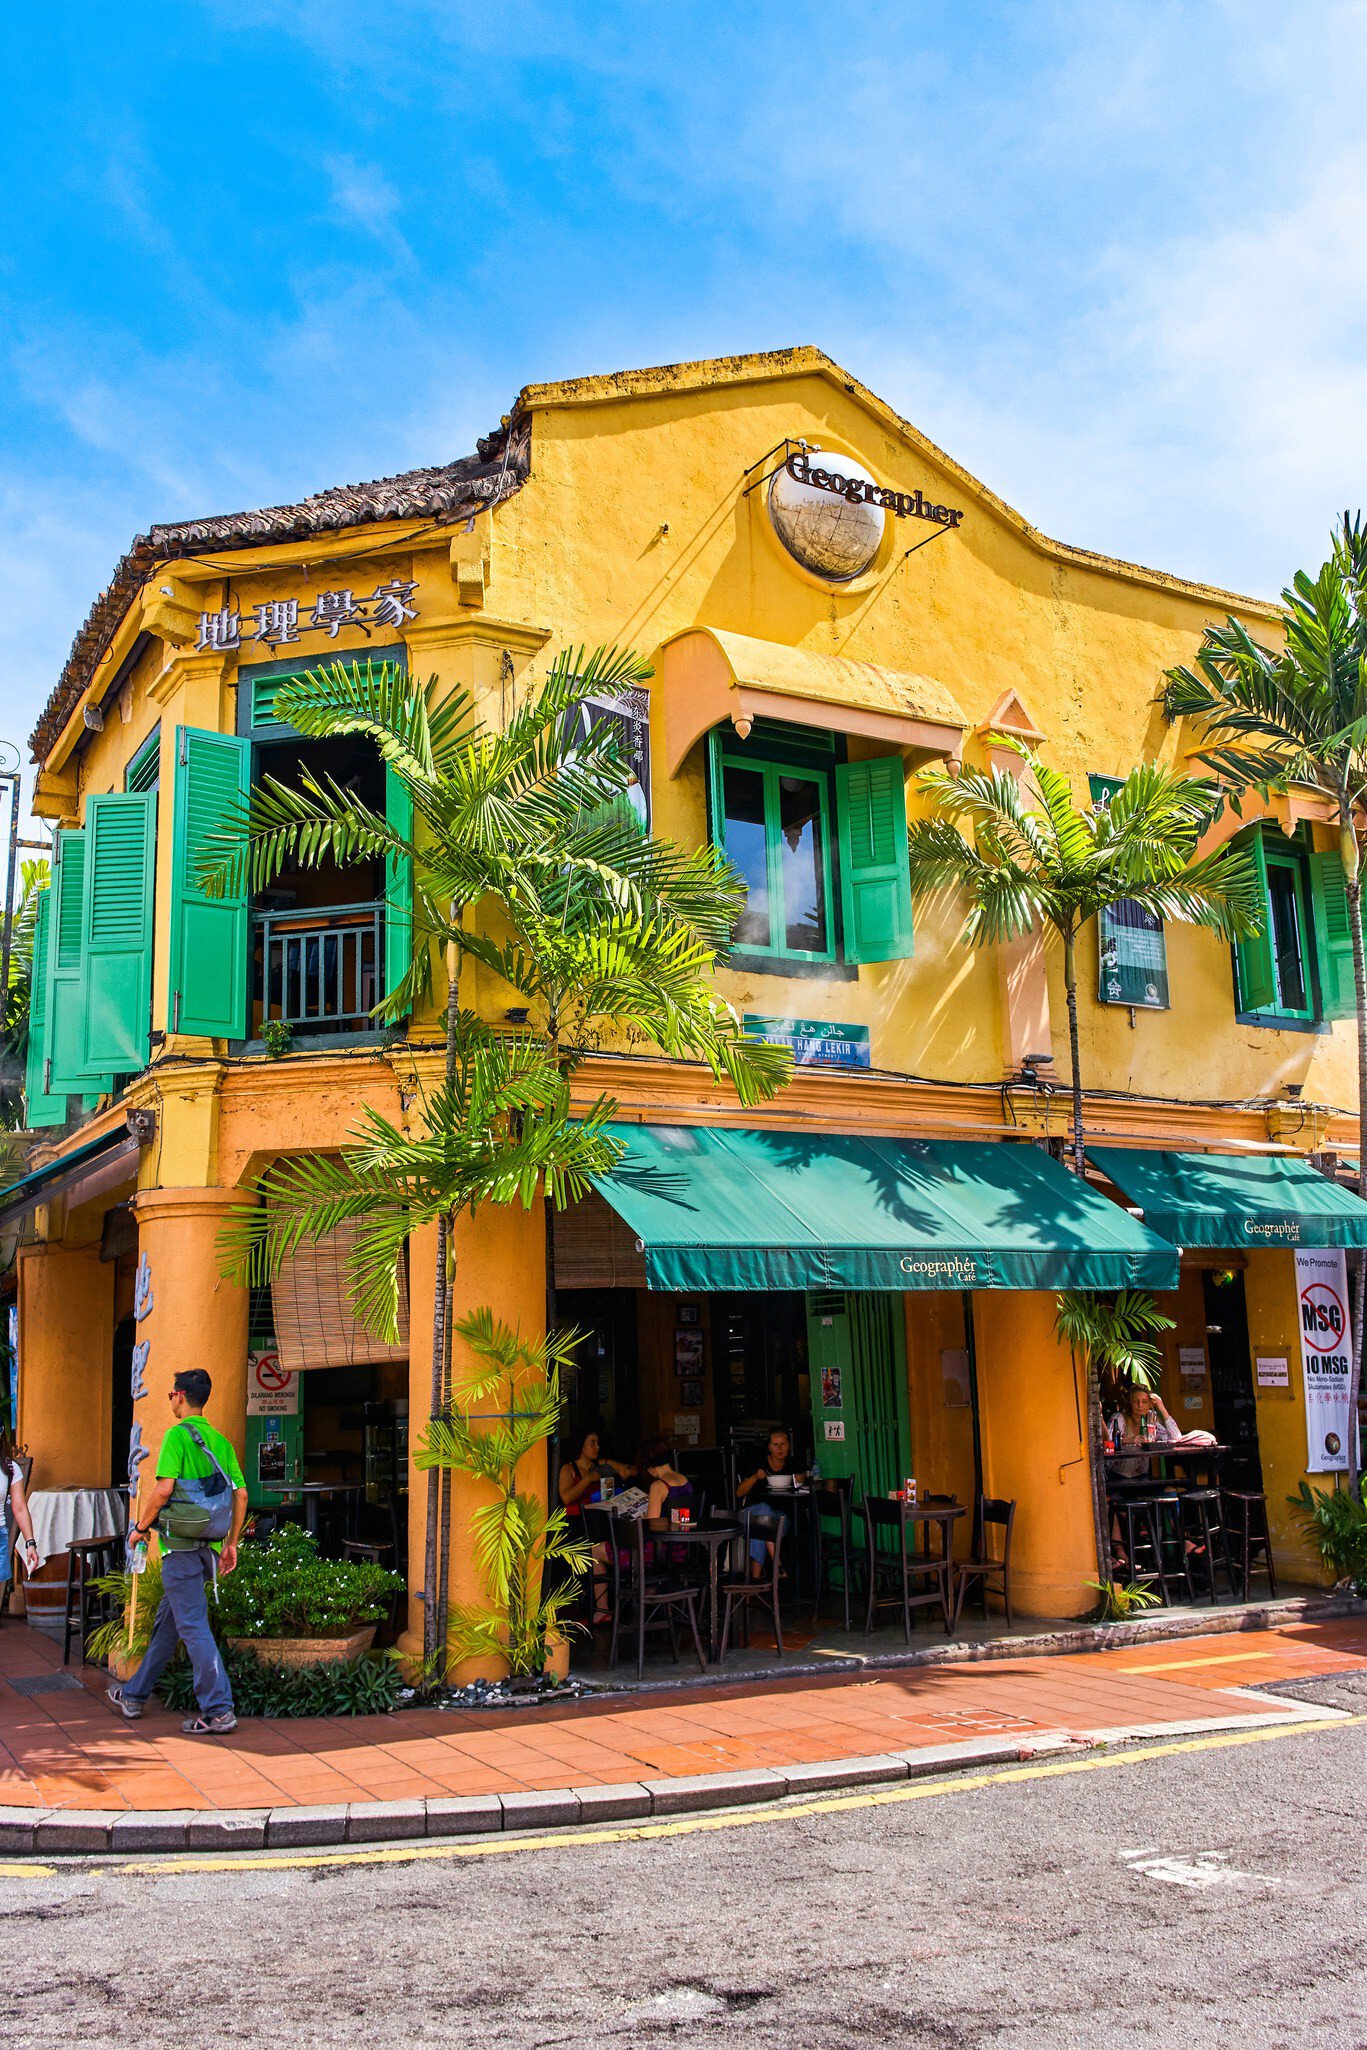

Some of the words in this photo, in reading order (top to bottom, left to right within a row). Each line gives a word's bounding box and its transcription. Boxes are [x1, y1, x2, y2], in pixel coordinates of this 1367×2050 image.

[786, 452, 964, 528] Geographer
[193, 578, 421, 652] 地理學家
[797, 1039, 821, 1052] HANG
[825, 1042, 850, 1054] LEKIR
[1244, 1220, 1300, 1238] Geographér
[900, 1256, 977, 1277] Geographér
[1296, 1258, 1309, 1266] We
[1310, 1258, 1337, 1268] Promote
[958, 1272, 976, 1281] Café
[1301, 1304, 1342, 1333] MSG
[1321, 1355, 1348, 1374] MSG
